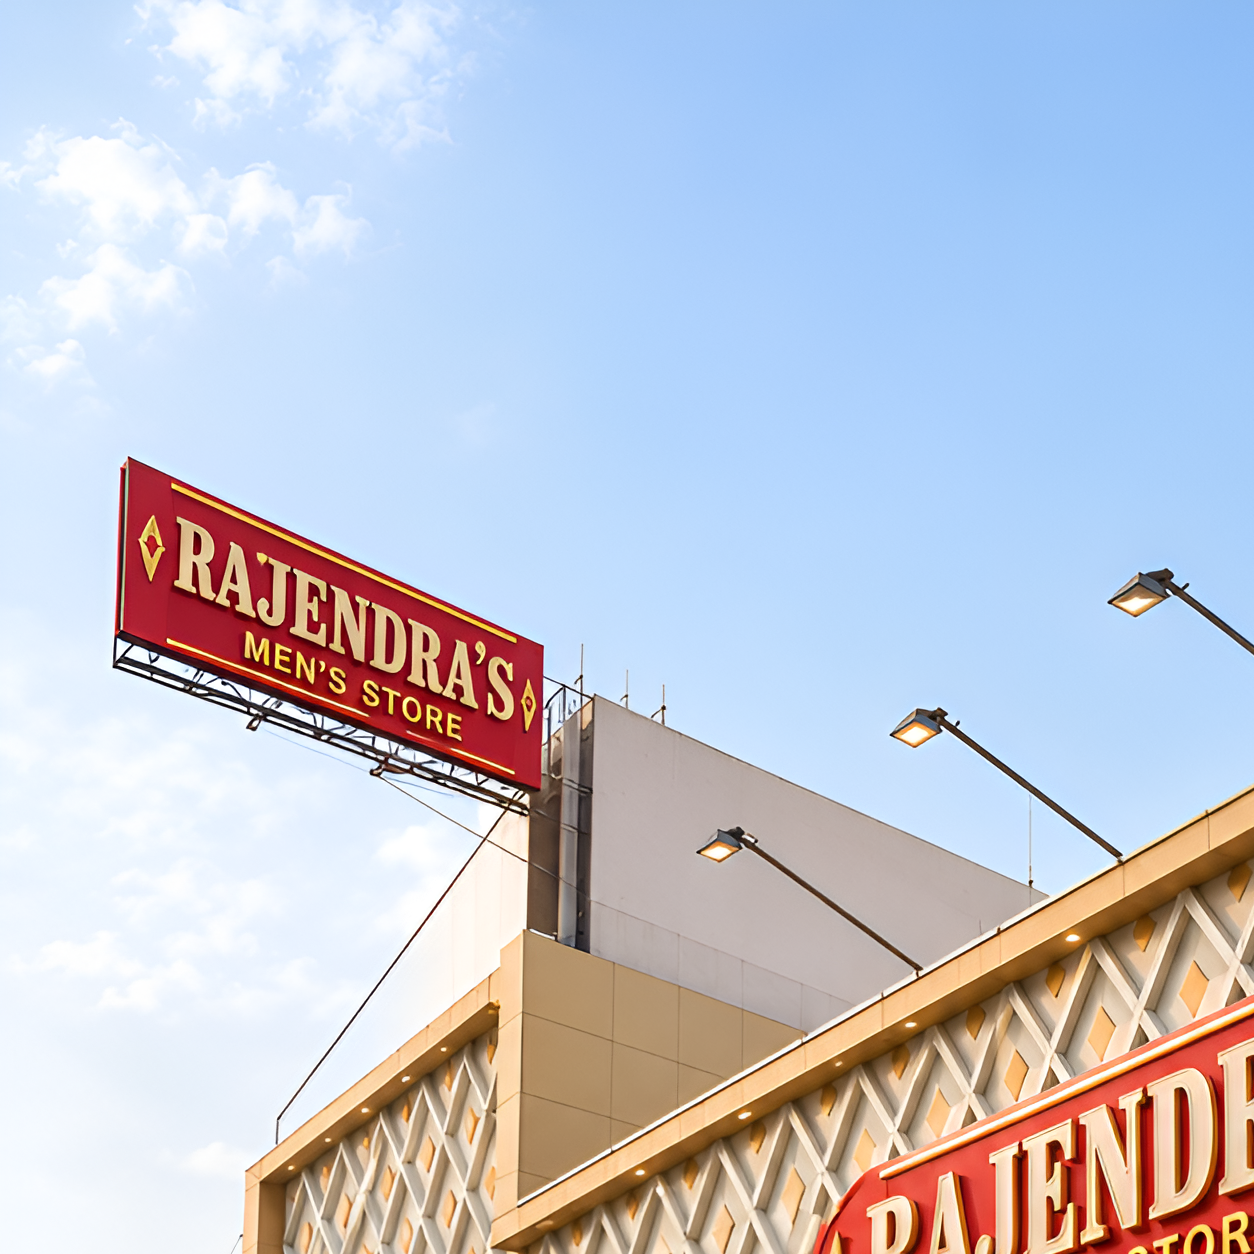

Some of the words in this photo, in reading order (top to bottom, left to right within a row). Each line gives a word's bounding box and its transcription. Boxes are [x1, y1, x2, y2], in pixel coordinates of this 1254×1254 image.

[174, 516, 515, 721] RAJENDRA'S
[244, 631, 347, 695] MEN'S
[362, 679, 463, 742] STORE
